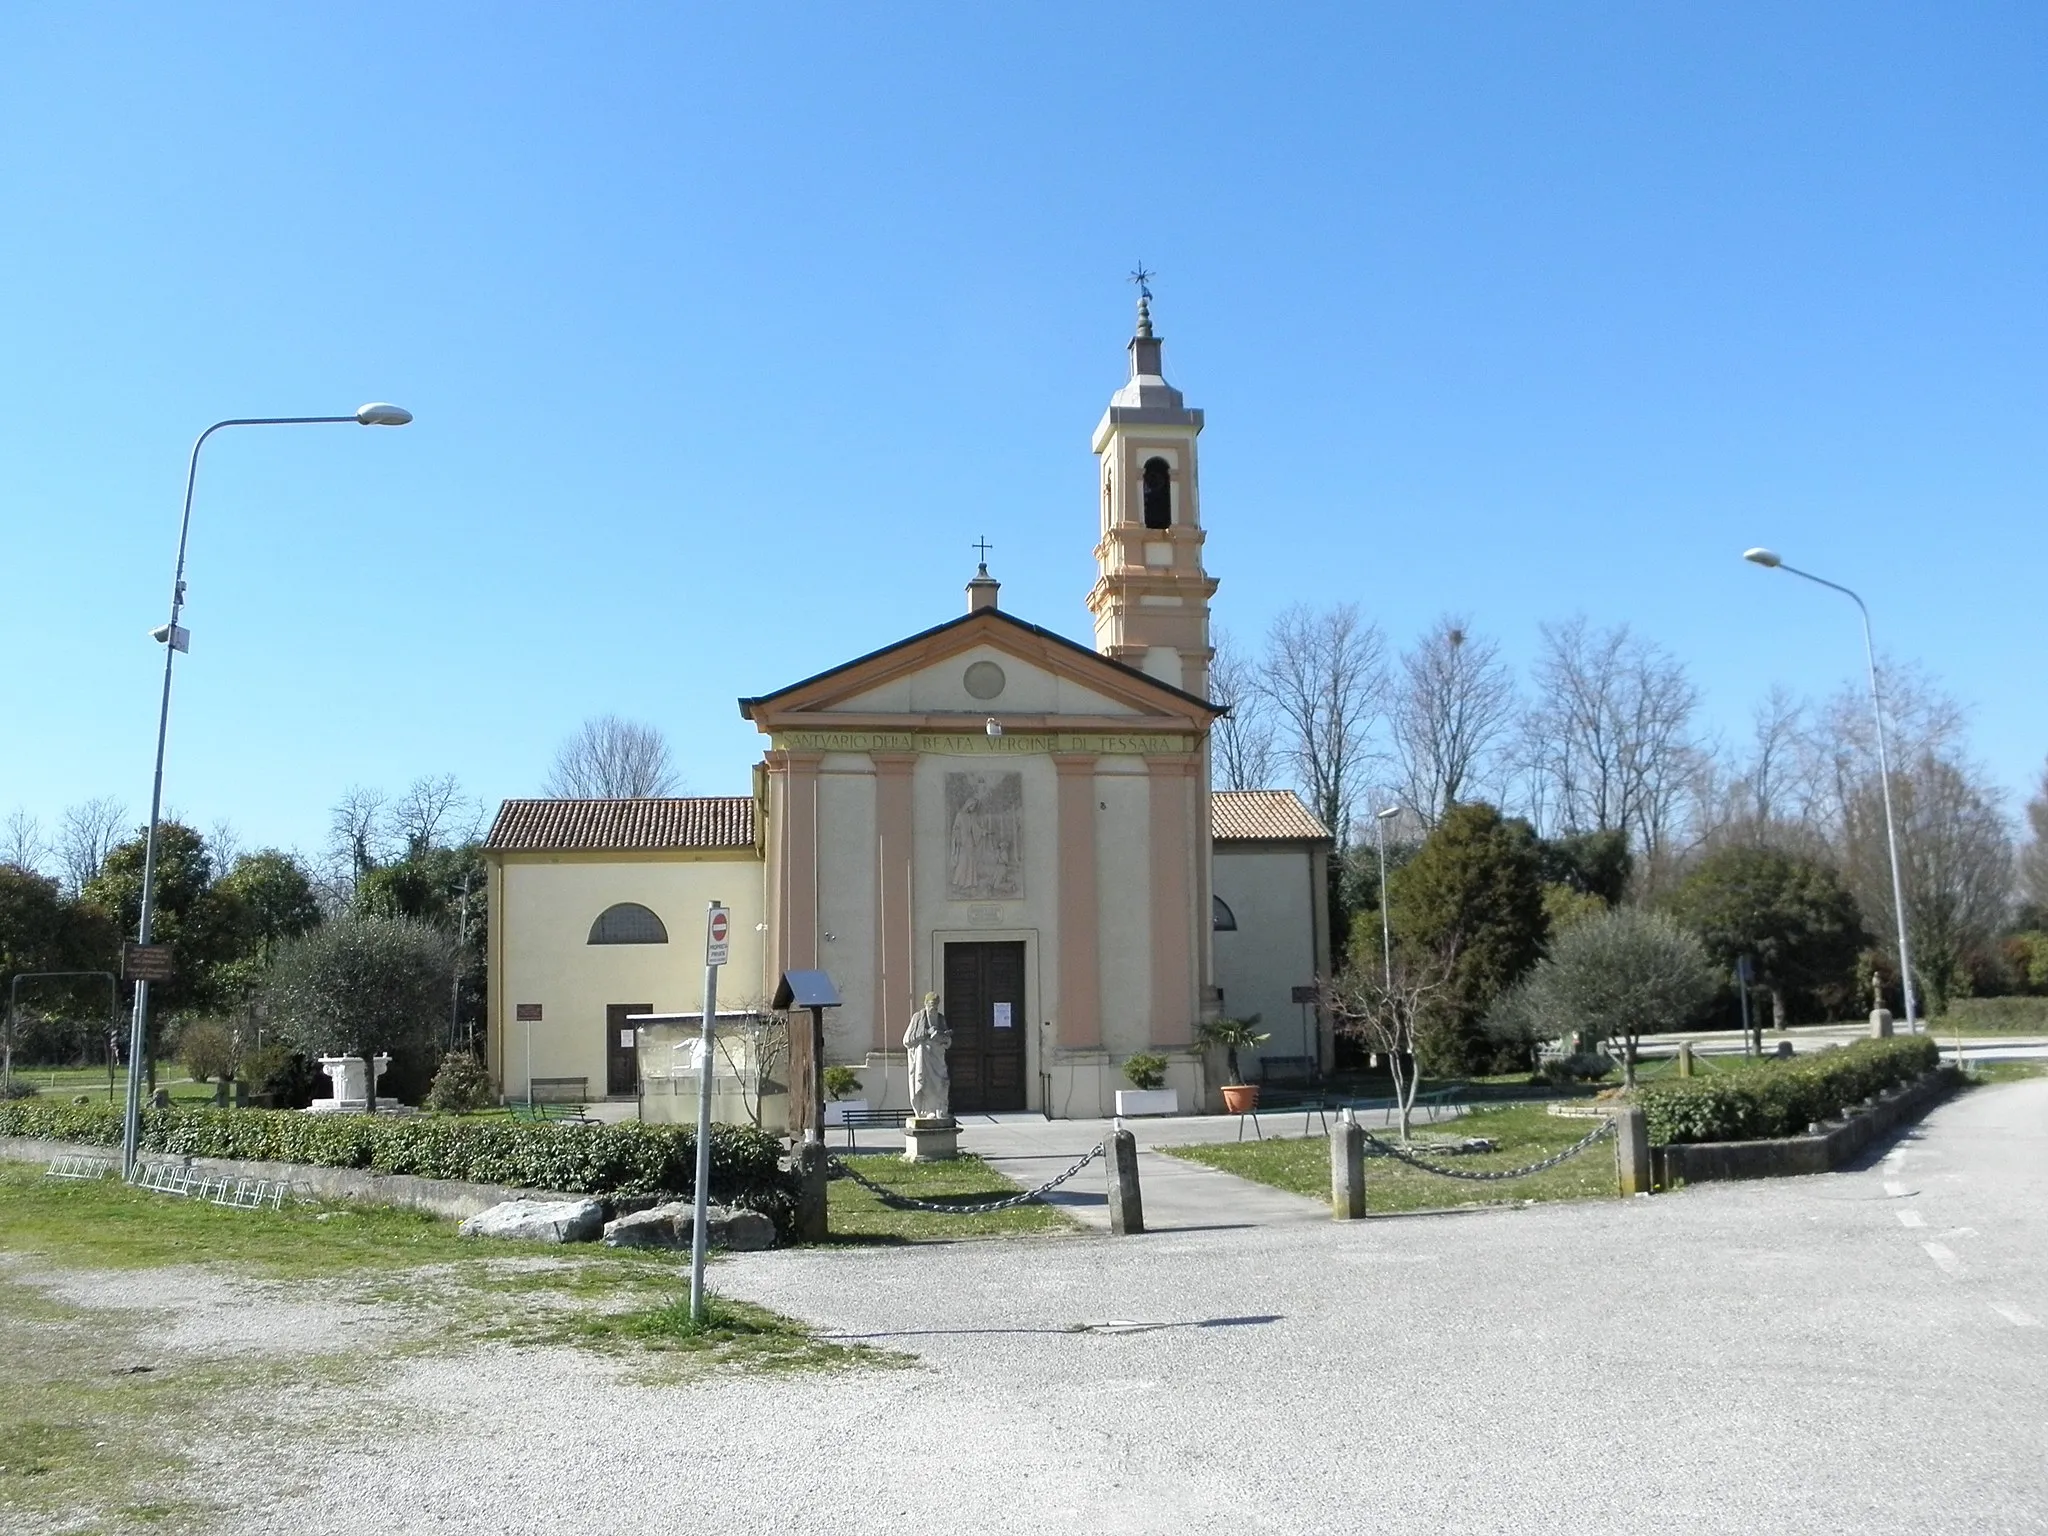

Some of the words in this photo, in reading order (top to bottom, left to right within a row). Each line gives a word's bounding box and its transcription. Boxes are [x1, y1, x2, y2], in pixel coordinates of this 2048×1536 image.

[784, 733, 866, 749] SANTVARIO
[872, 734, 910, 749] DELLA
[922, 735, 974, 750] BEATA
[985, 736, 1057, 752] VERGINE
[1072, 736, 1088, 751] DI
[1098, 737, 1169, 752] TESSARA
